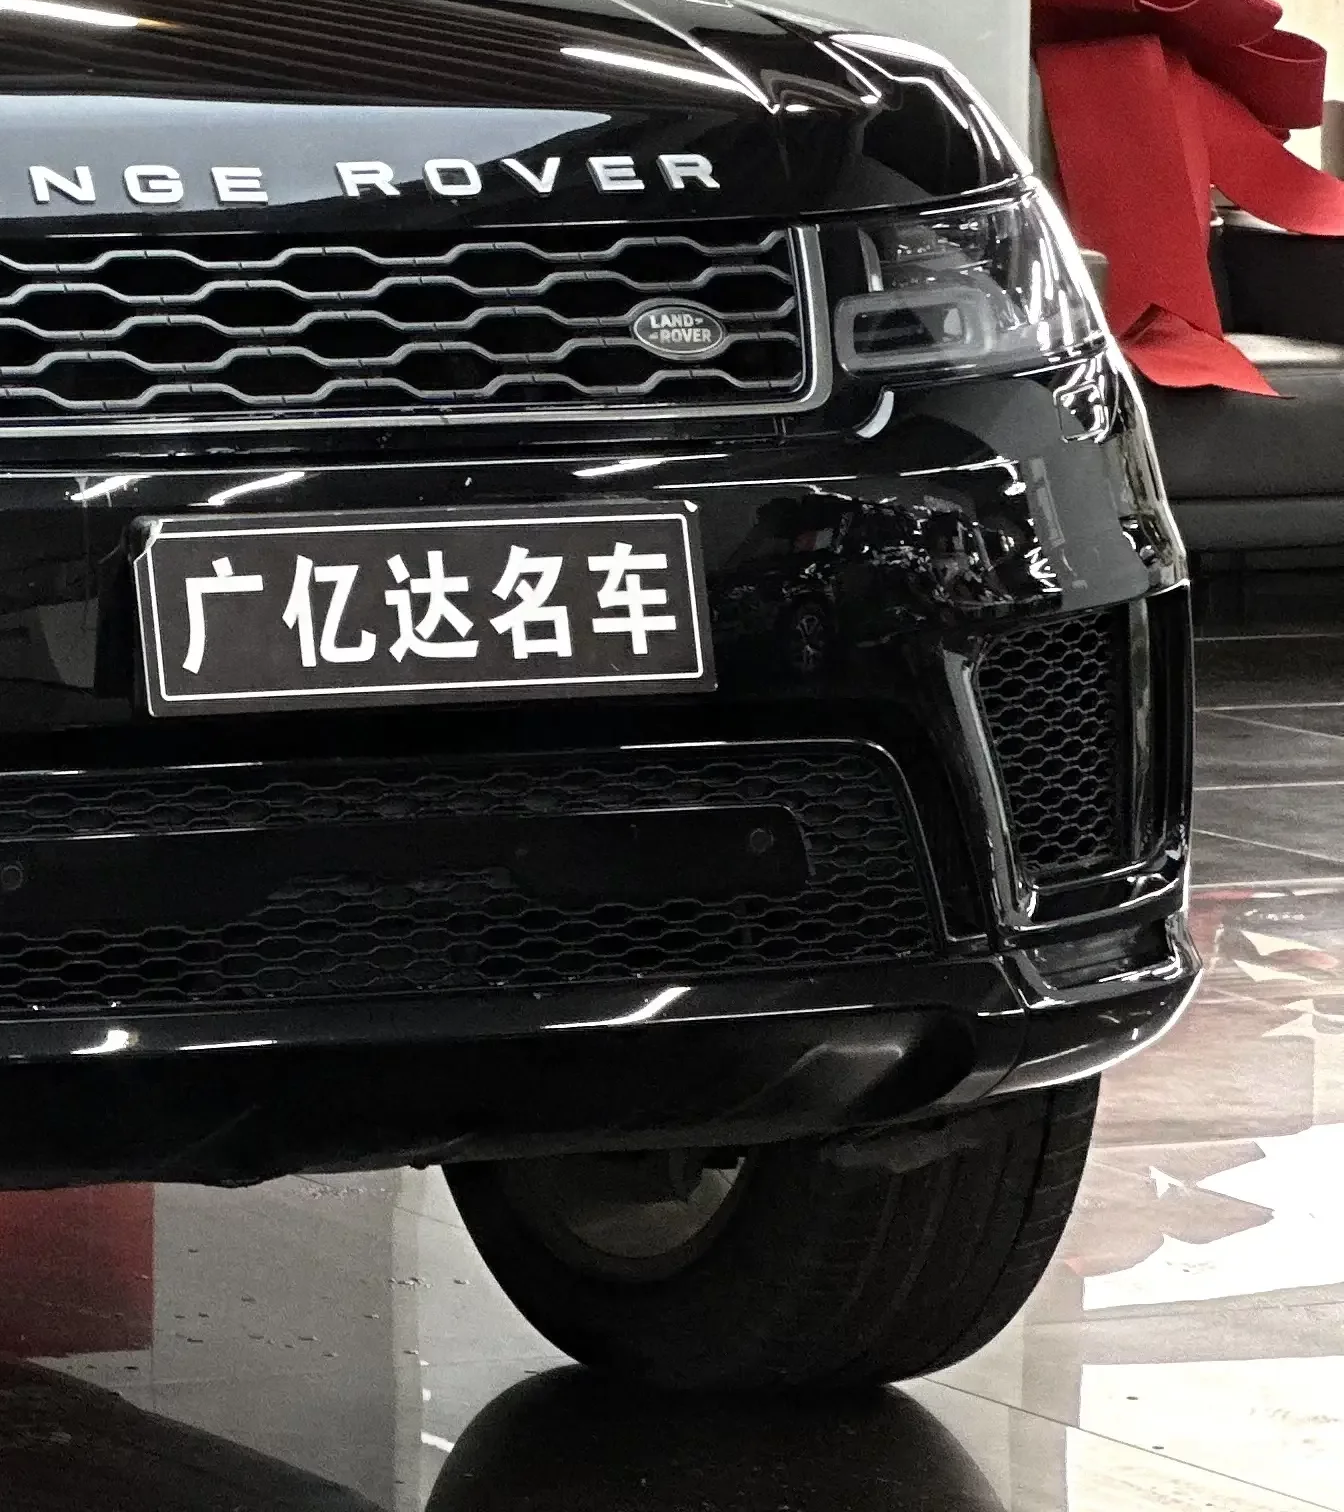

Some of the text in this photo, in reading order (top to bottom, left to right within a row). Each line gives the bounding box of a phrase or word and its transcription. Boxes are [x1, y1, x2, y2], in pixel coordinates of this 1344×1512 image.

[335, 154, 721, 198] ROVER
[649, 313, 695, 329] LAND
[659, 327, 712, 344] ROVER
[180, 542, 678, 675] 广亿达名车
